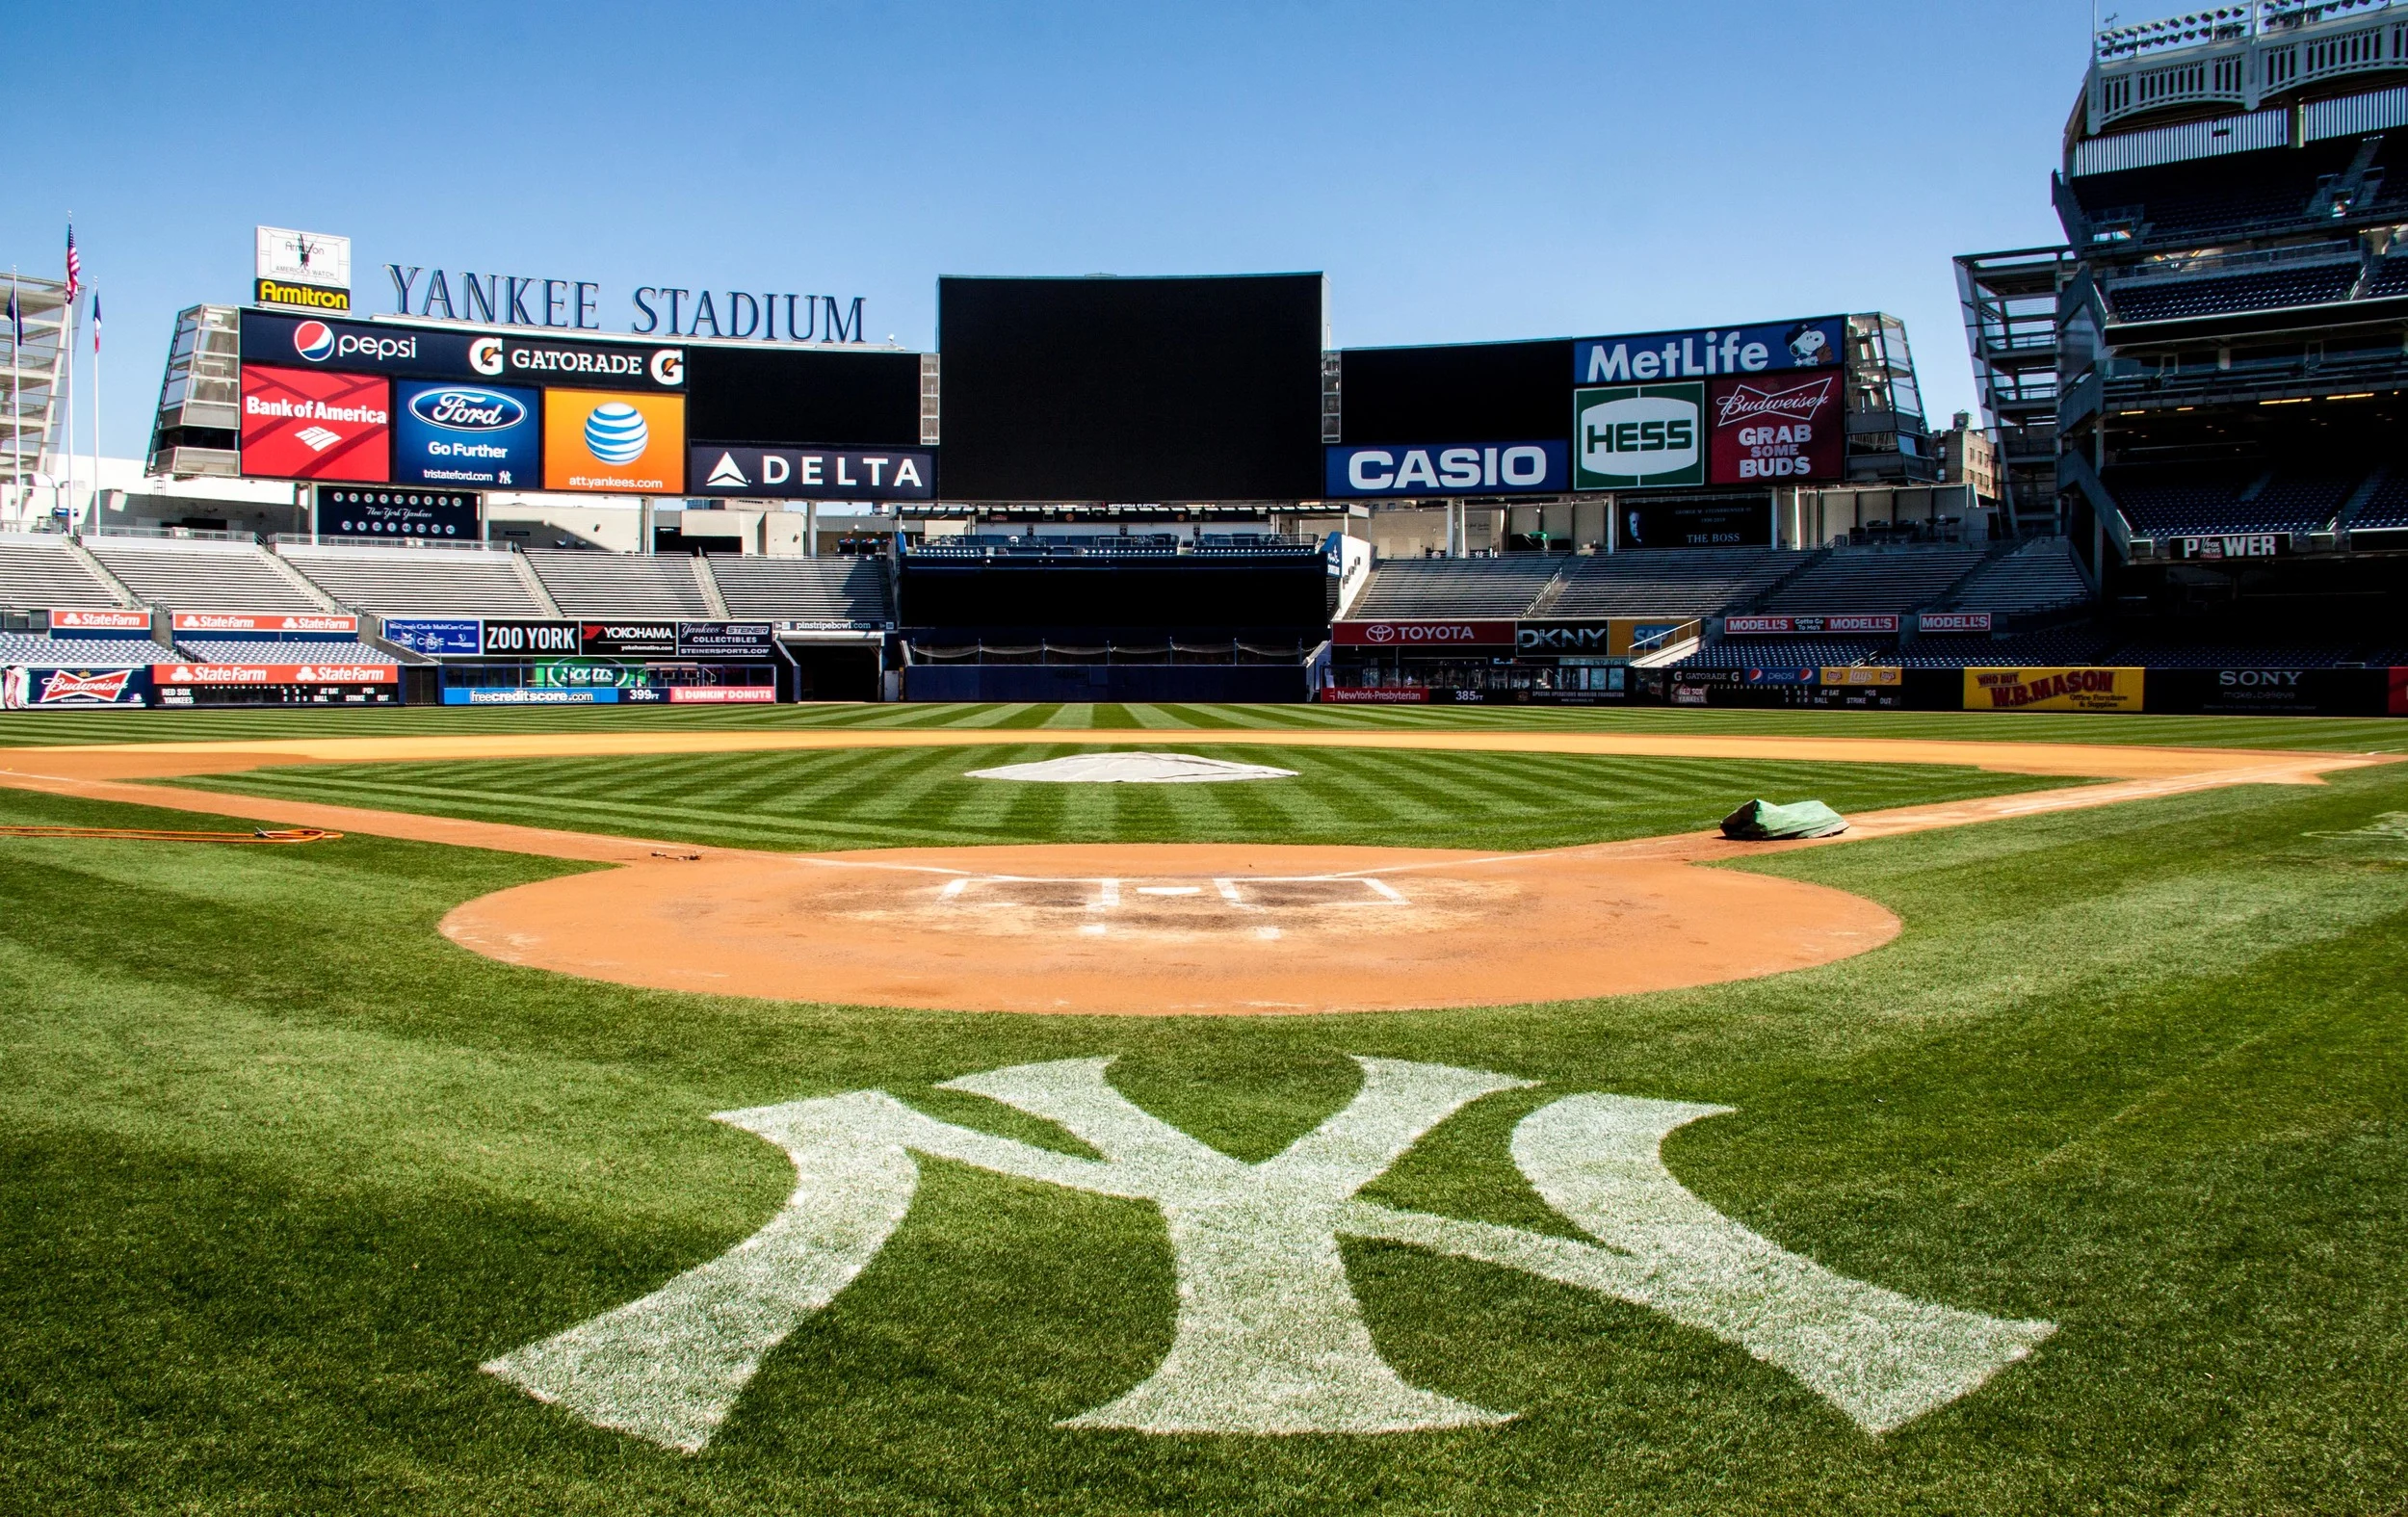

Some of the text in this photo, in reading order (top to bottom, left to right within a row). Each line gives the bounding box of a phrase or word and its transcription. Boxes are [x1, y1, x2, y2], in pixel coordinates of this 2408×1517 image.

[260, 279, 349, 308] Armitron
[382, 263, 867, 344] YANKEE STADIUM
[338, 333, 417, 361] pepsi
[511, 348, 642, 376] GATORADE
[1587, 331, 1768, 382] MetLife
[246, 395, 387, 425] Bank of America
[432, 392, 505, 426] Ford
[1716, 392, 1829, 416] Budweiser
[1586, 419, 1692, 455] HESS
[1738, 424, 1813, 446] GRAB
[428, 441, 509, 458] Go Further
[1750, 444, 1799, 458] SOME
[763, 455, 923, 488] DELTA
[1348, 445, 1547, 489] CASIO
[1739, 457, 1812, 479] BUDS
[568, 474, 663, 490] att.yankees.com
[365, 506, 432, 521] New York Yankees
[1687, 532, 1741, 543] THE BOSS
[681, 622, 720, 639] Yankees
[796, 621, 871, 631] pinstripebowl.com
[1729, 619, 1788, 631] MODELL'S
[1829, 618, 1892, 629] MODELL'S
[1922, 616, 1988, 628] MODELL'S
[486, 626, 577, 650] ZOO YORK
[604, 626, 674, 639] YOKOHAMA
[1398, 626, 1475, 641] TOYOTA
[1517, 628, 1607, 648] DKNY
[40, 677, 129, 693] Budweiser
[1767, 671, 1795, 682] pepsi
[1977, 673, 2019, 685] WHO BUT
[2218, 669, 2304, 686] SONY
[162, 688, 192, 696] RED SOX
[469, 689, 594, 703] freecreditscore.com
[684, 689, 772, 700] DUNKIN' DONUTS
[2223, 690, 2296, 699] make.believe
